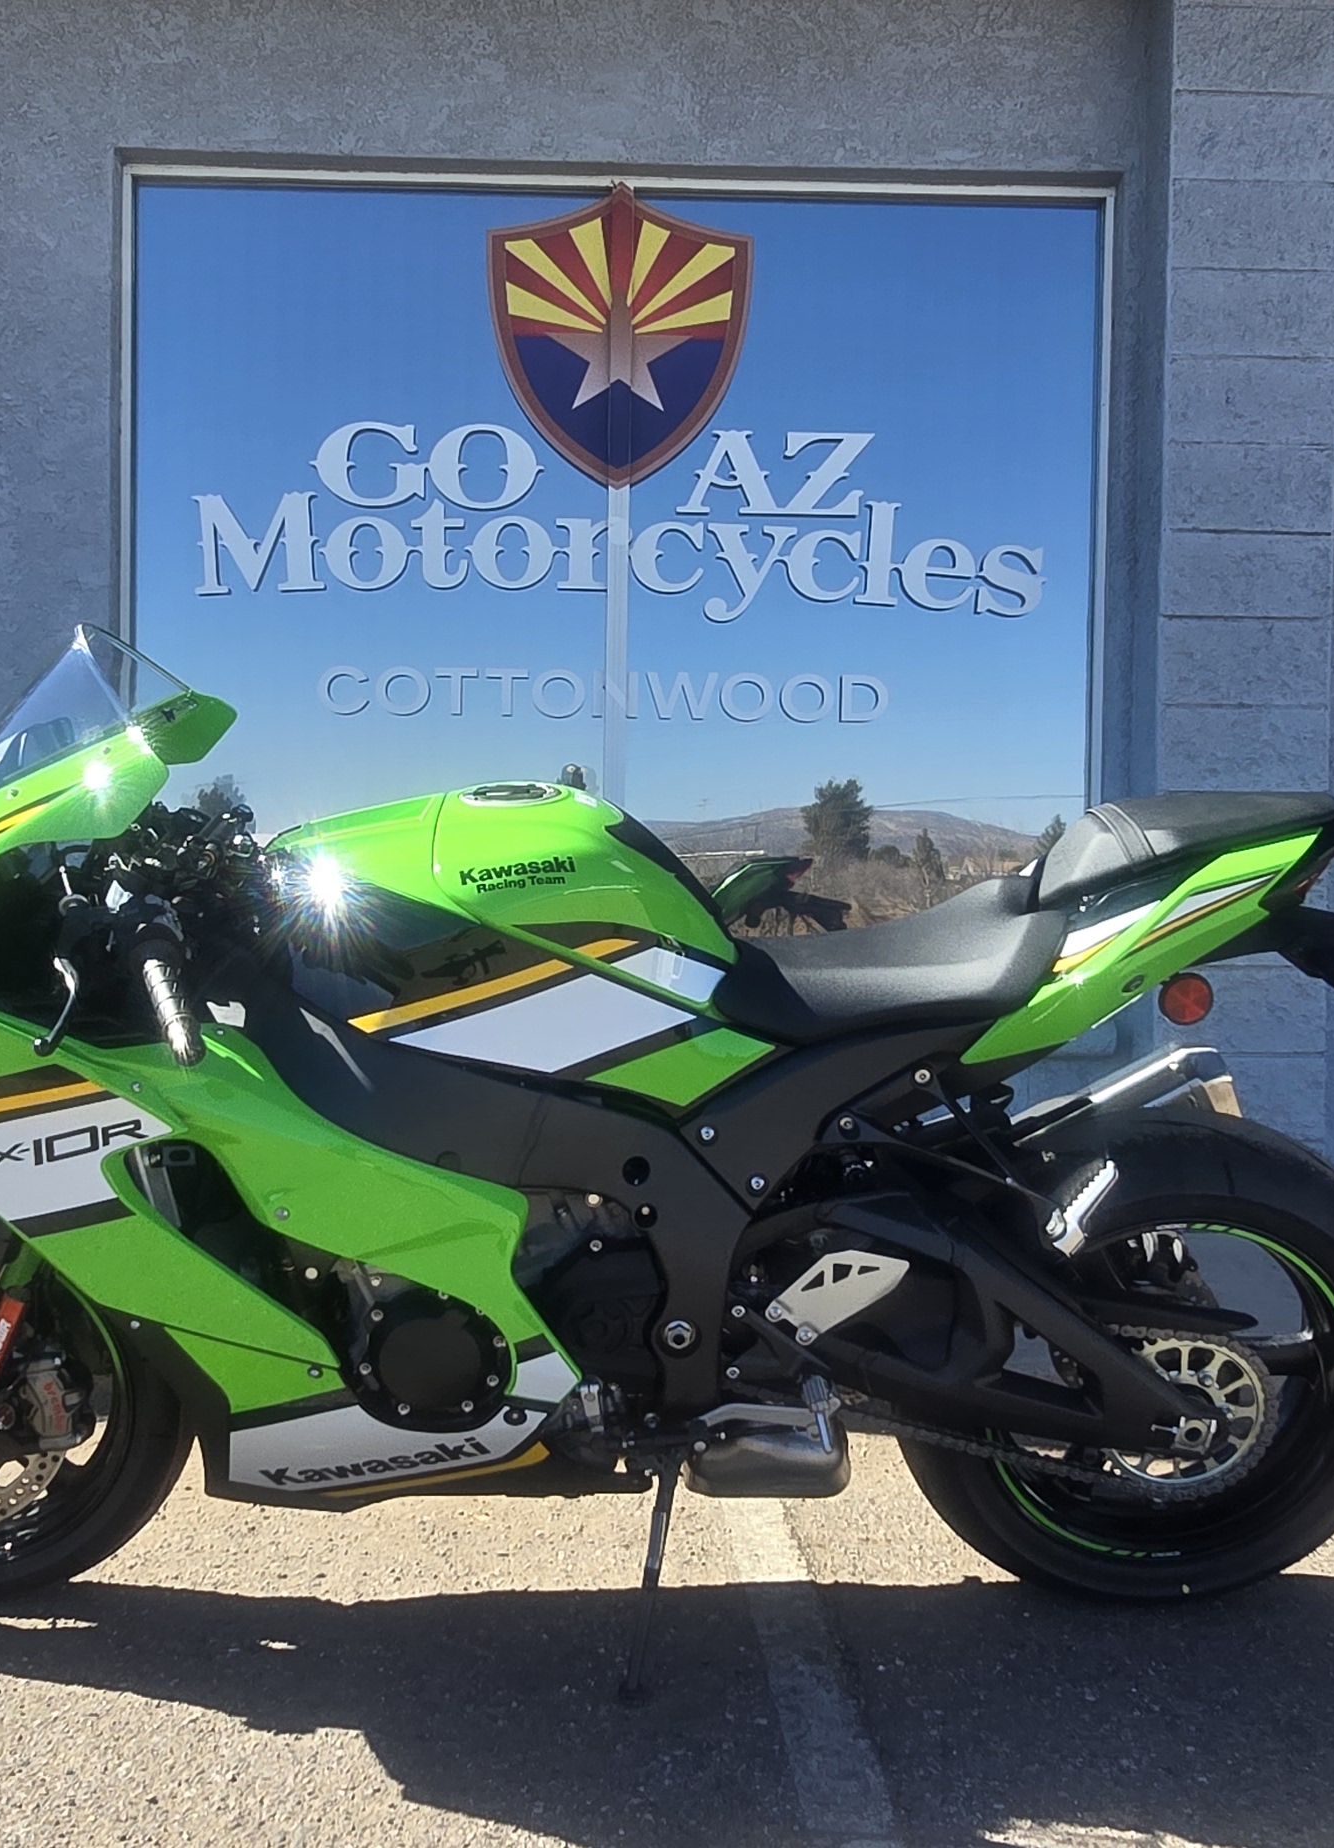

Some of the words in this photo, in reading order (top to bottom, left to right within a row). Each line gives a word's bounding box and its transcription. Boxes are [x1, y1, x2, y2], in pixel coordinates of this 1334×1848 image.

[309, 420, 545, 511] GO
[675, 429, 876, 518] AZ
[191, 490, 1047, 624] Motorcycles
[317, 665, 890, 724] COTTONWOOD
[459, 856, 576, 886] Kawasaki
[476, 878, 526, 894] Racing
[527, 875, 566, 886] Team
[259, 1436, 491, 1486] Kawasaki
